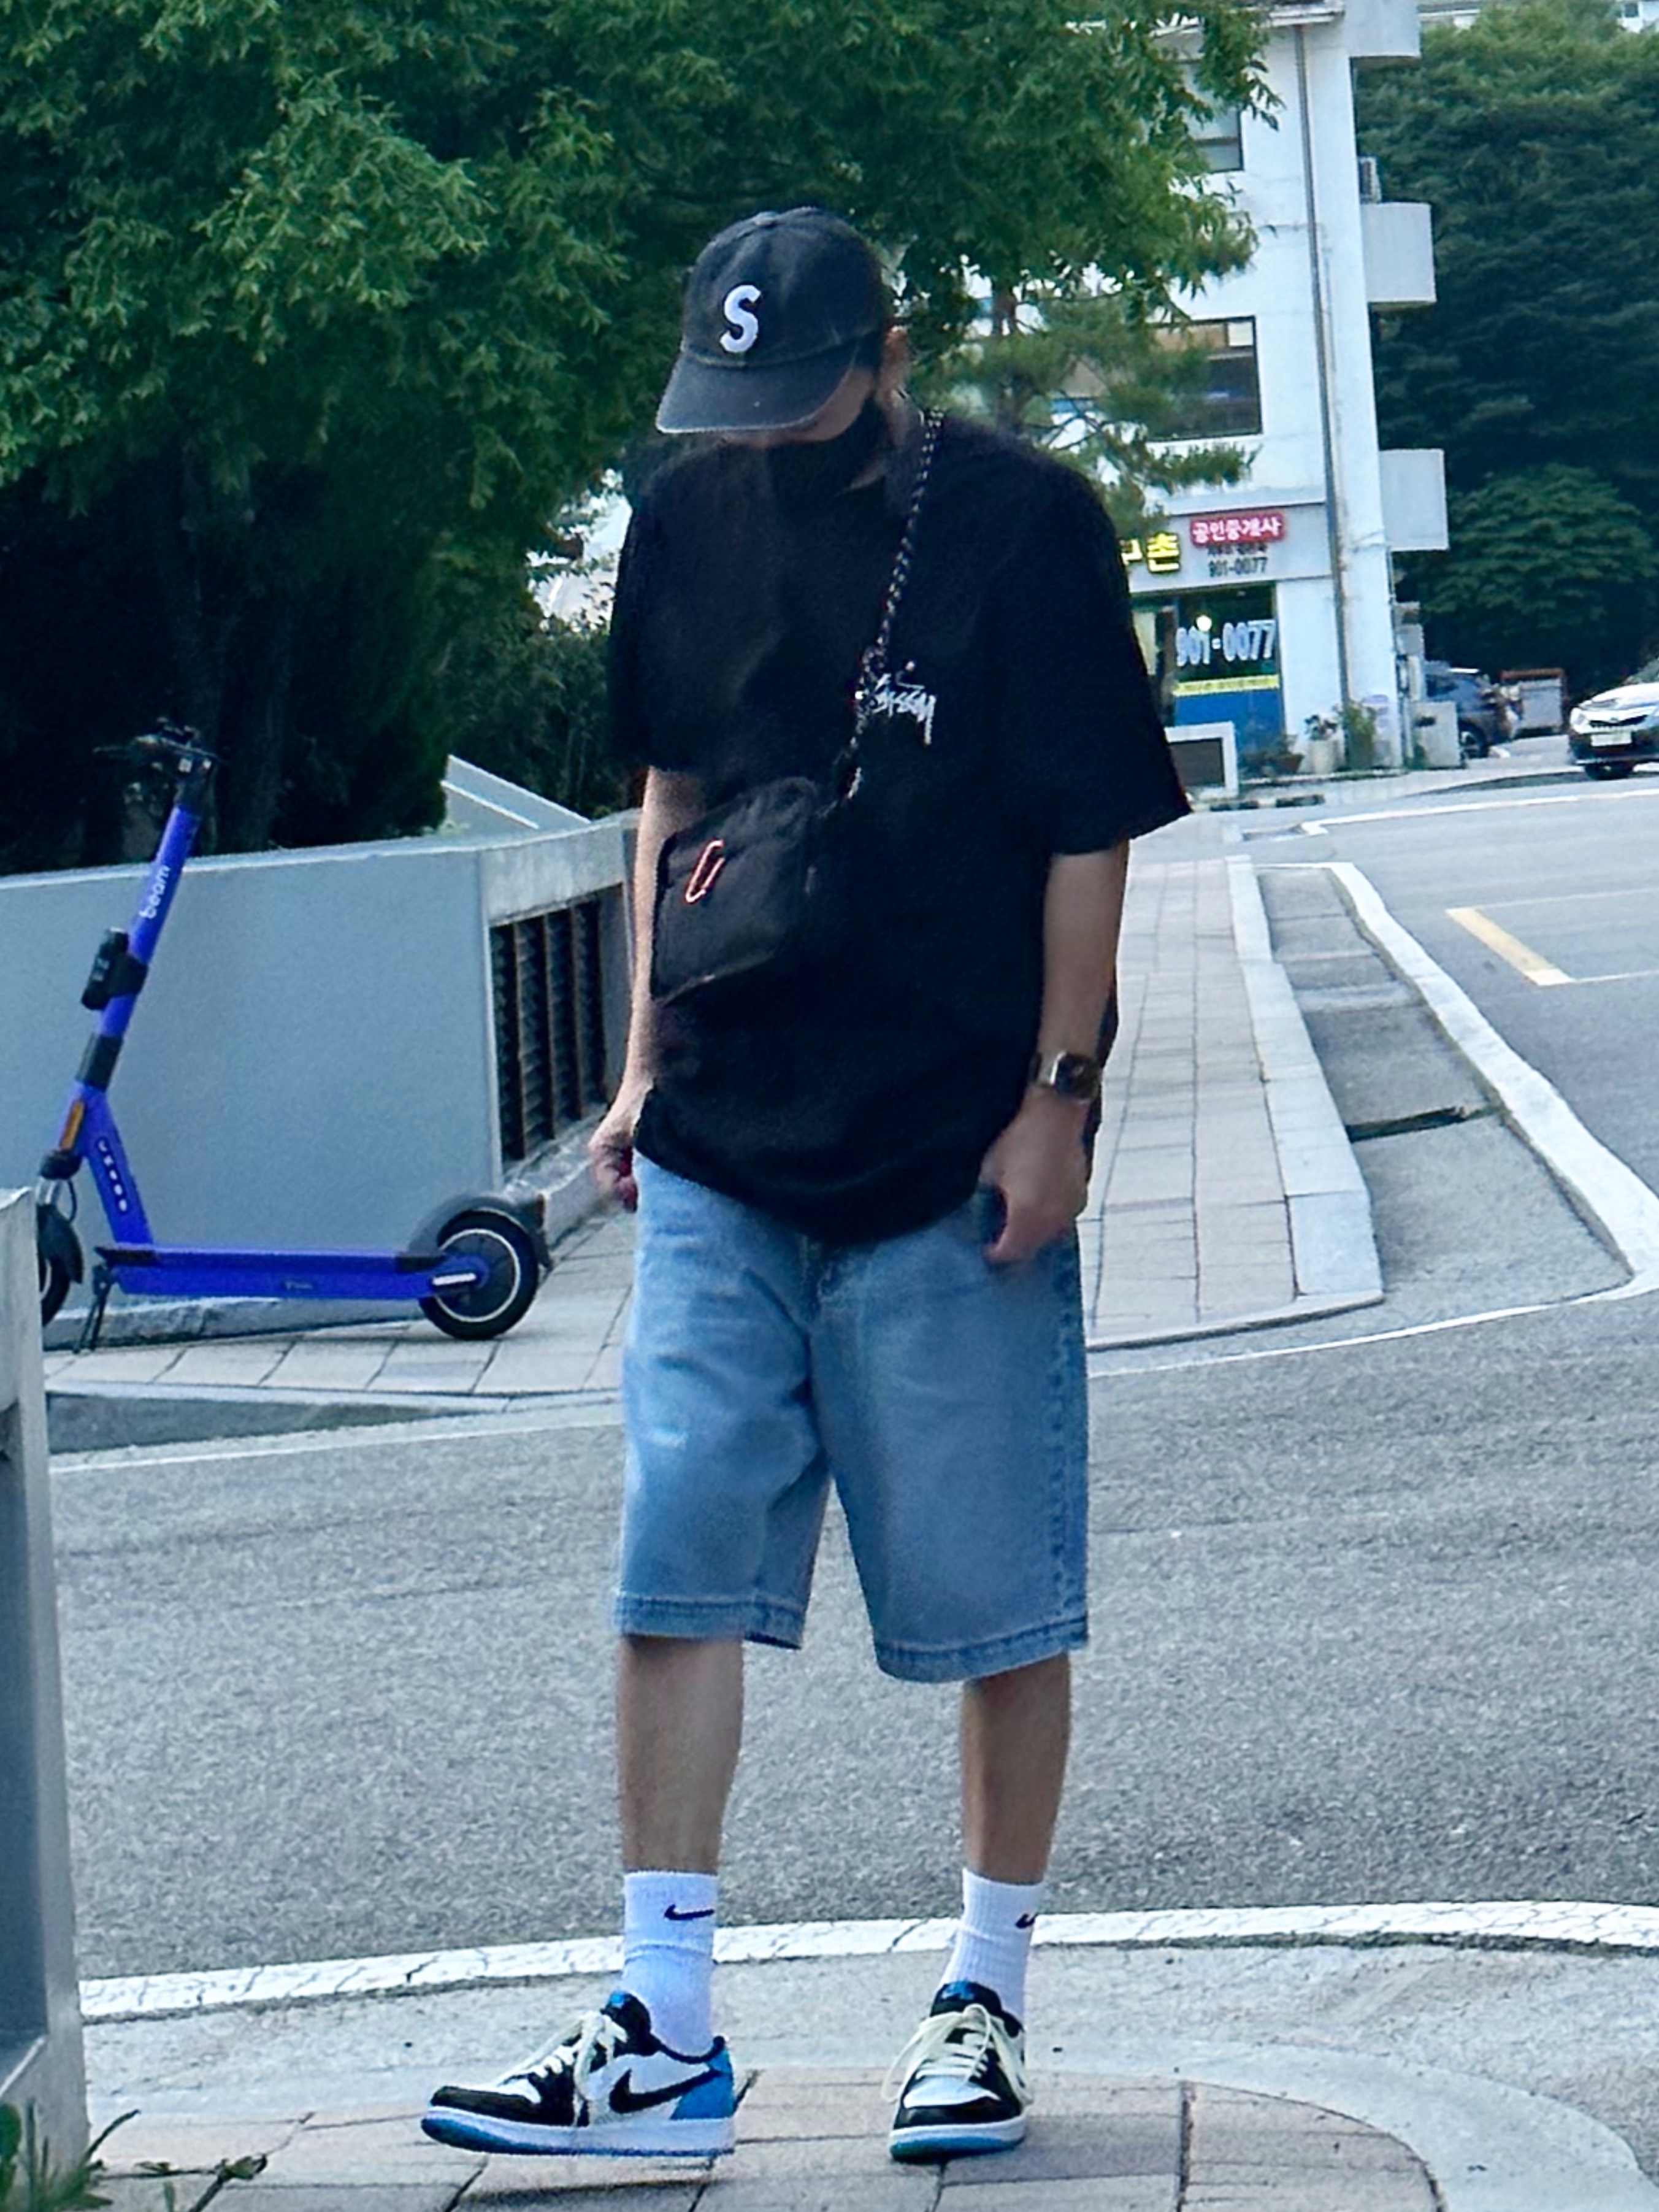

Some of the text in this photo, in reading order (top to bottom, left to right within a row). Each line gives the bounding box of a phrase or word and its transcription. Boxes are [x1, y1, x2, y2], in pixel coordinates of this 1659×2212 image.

[719, 285, 761, 353] S
[1192, 517, 1282, 543] 공인중개사
[1208, 557, 1268, 577] 901-0077
[1176, 620, 1276, 666] 901-0077
[139, 864, 170, 919] beam
